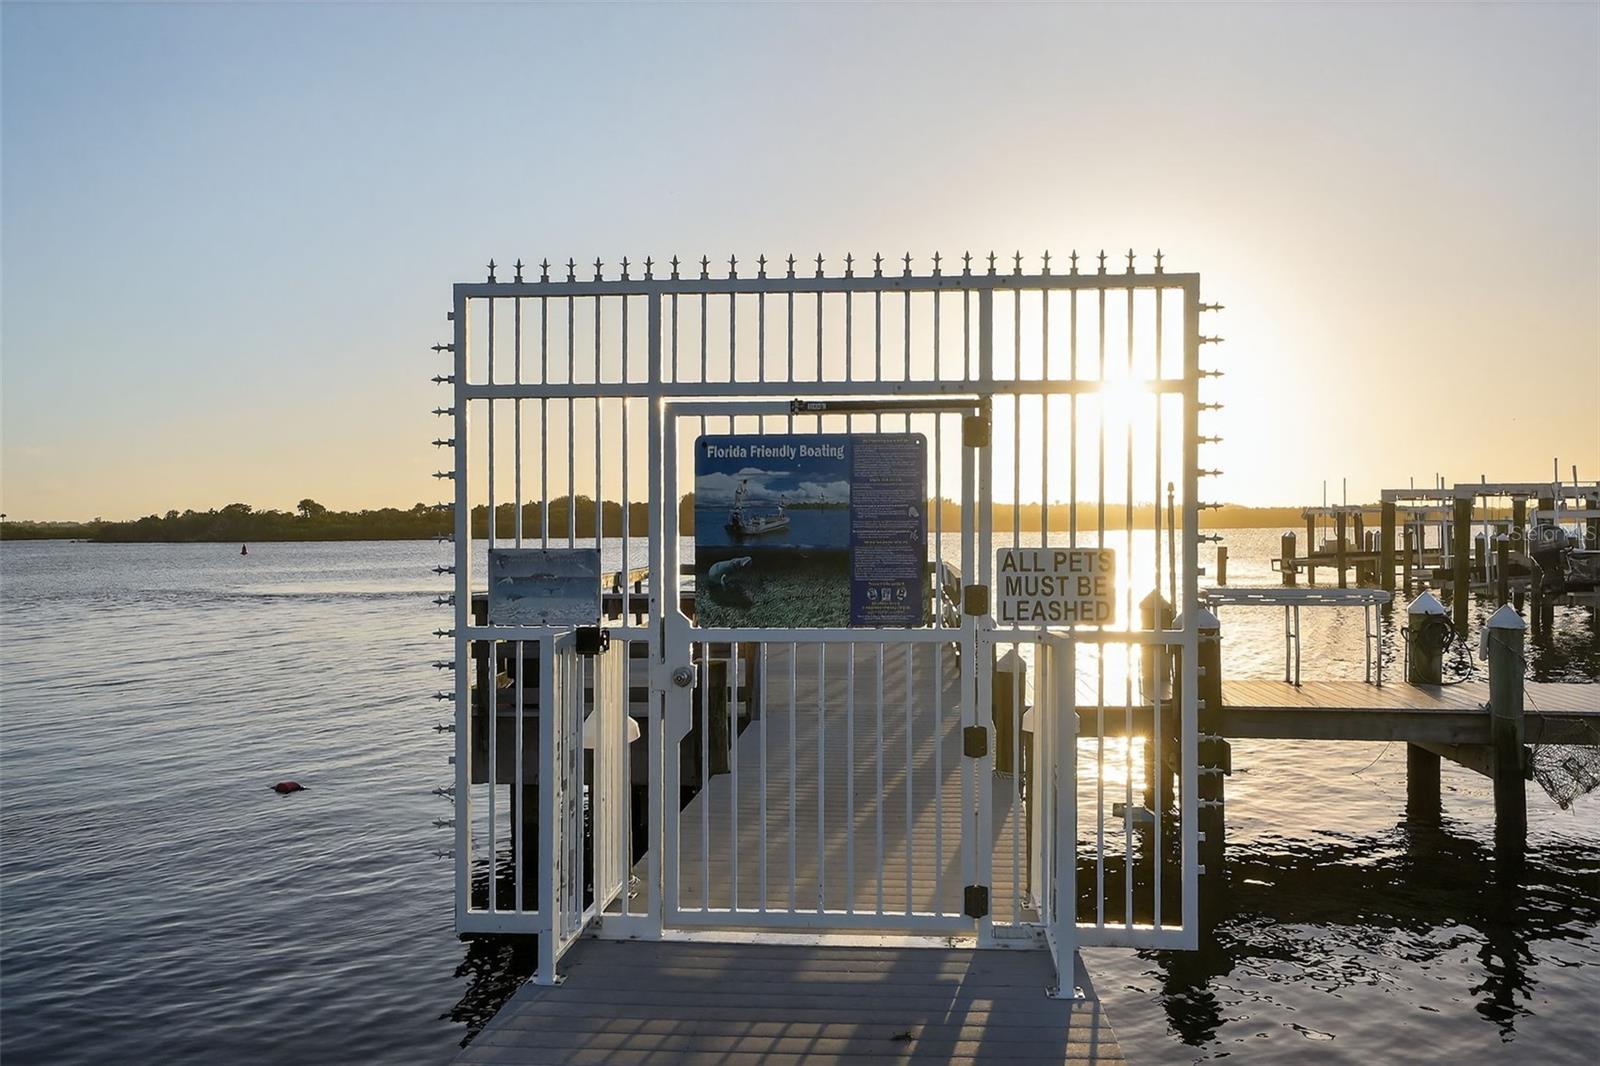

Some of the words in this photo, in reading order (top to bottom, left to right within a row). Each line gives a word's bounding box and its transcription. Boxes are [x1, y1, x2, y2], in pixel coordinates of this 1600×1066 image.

[706, 445, 747, 458] Florida
[750, 445, 796, 461] Friendly
[799, 444, 845, 459] Boating
[1001, 551, 1046, 572] ALL
[1054, 551, 1111, 572] PETS
[1005, 575, 1069, 597] MUST
[1077, 576, 1107, 596] BE
[1002, 600, 1110, 621] LEASHED
